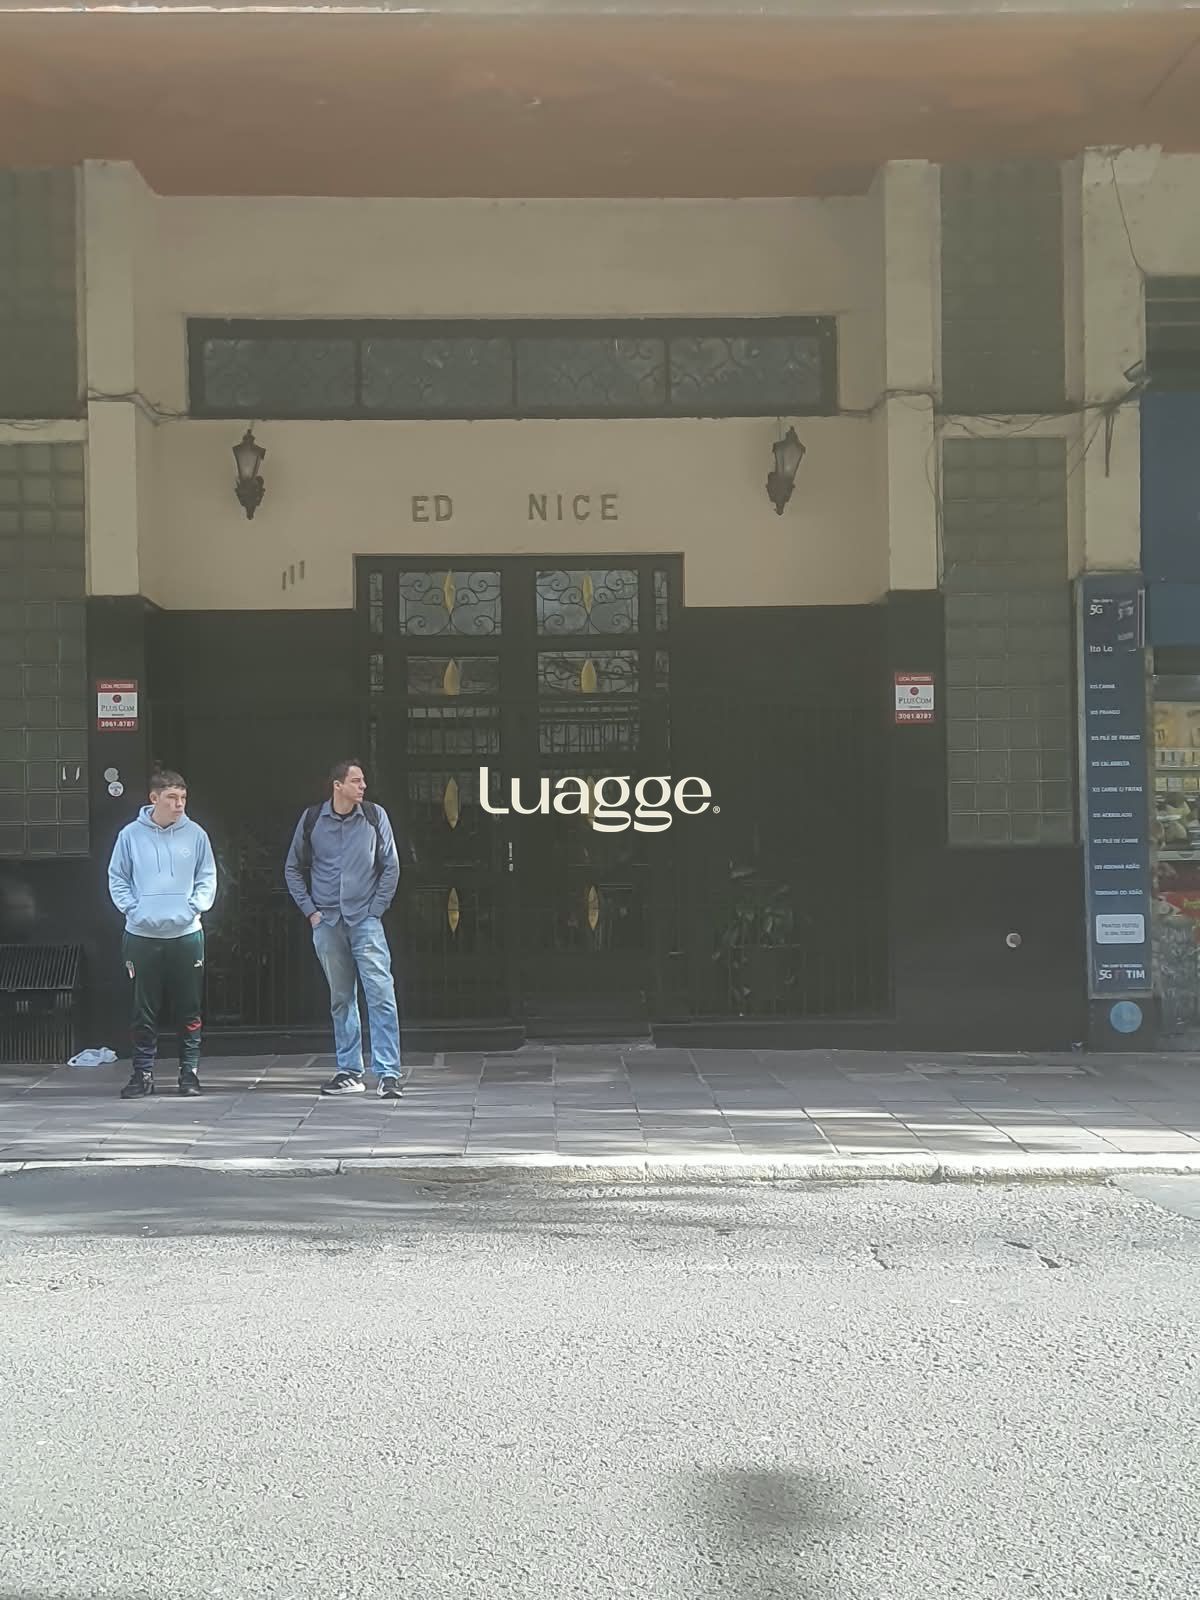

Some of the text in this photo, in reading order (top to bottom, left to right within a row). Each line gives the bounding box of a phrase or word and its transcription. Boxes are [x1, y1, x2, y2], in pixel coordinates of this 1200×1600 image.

[410, 493, 619, 522] ED NICE
[1089, 604, 1104, 616] 5G
[1098, 969, 1145, 980] 5G TIM
